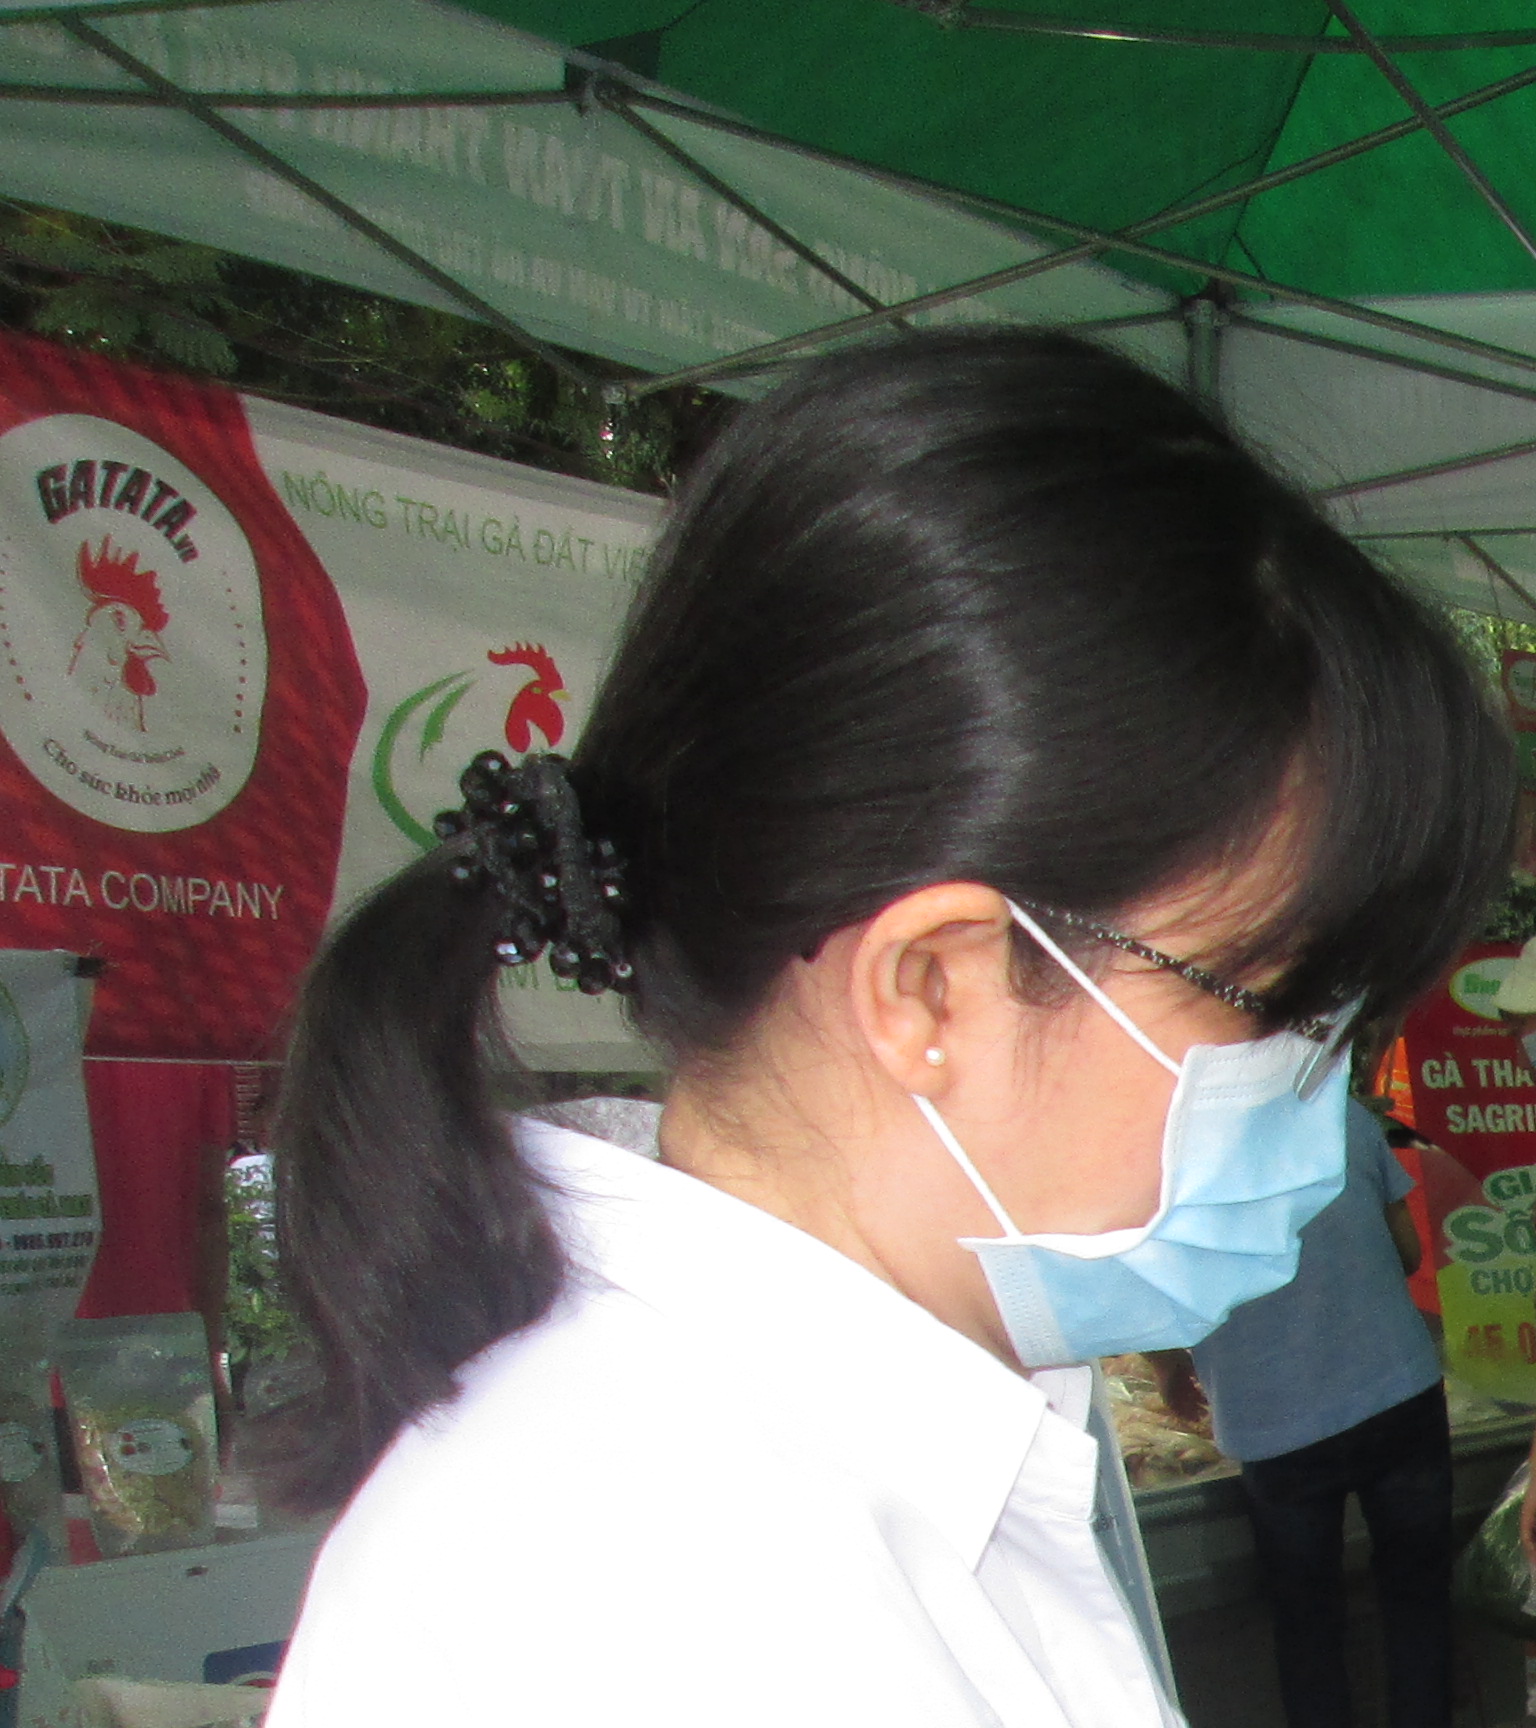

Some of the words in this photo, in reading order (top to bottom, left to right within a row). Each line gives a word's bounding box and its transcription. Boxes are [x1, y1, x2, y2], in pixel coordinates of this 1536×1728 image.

[37, 458, 198, 540] GATATA
[281, 470, 389, 530] NÔNG
[394, 496, 470, 552] TRẠI
[481, 514, 527, 563] GÀ
[102, 870, 285, 921] COMPANY
[1421, 1051, 1464, 1089] GÀ
